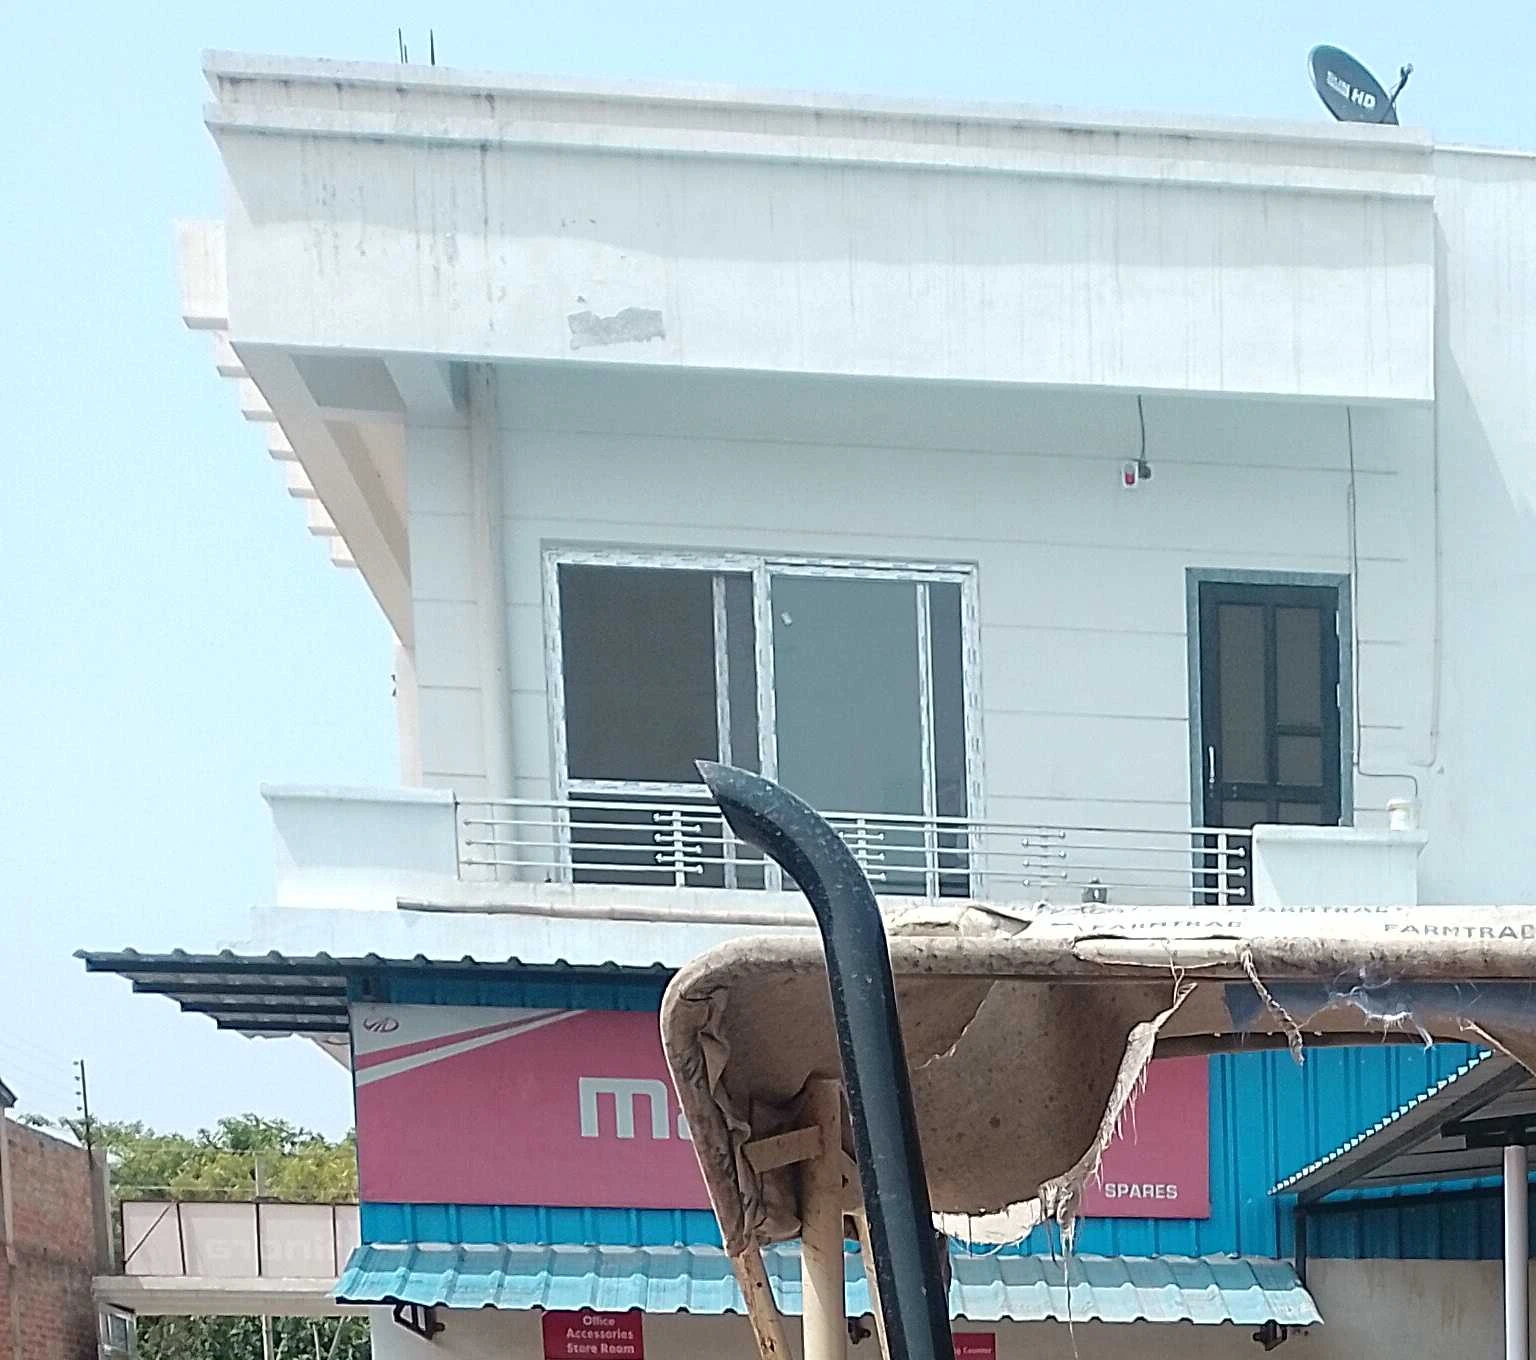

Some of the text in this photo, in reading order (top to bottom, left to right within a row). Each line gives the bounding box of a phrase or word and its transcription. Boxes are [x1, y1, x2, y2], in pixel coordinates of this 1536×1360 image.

[1351, 87, 1376, 108] HD
[1383, 923, 1536, 940] FARMTRAC
[1104, 1183, 1178, 1199] SPARES
[583, 1315, 616, 1326] Office
[566, 1328, 634, 1340] Accessories
[567, 1343, 635, 1354] Store Room
